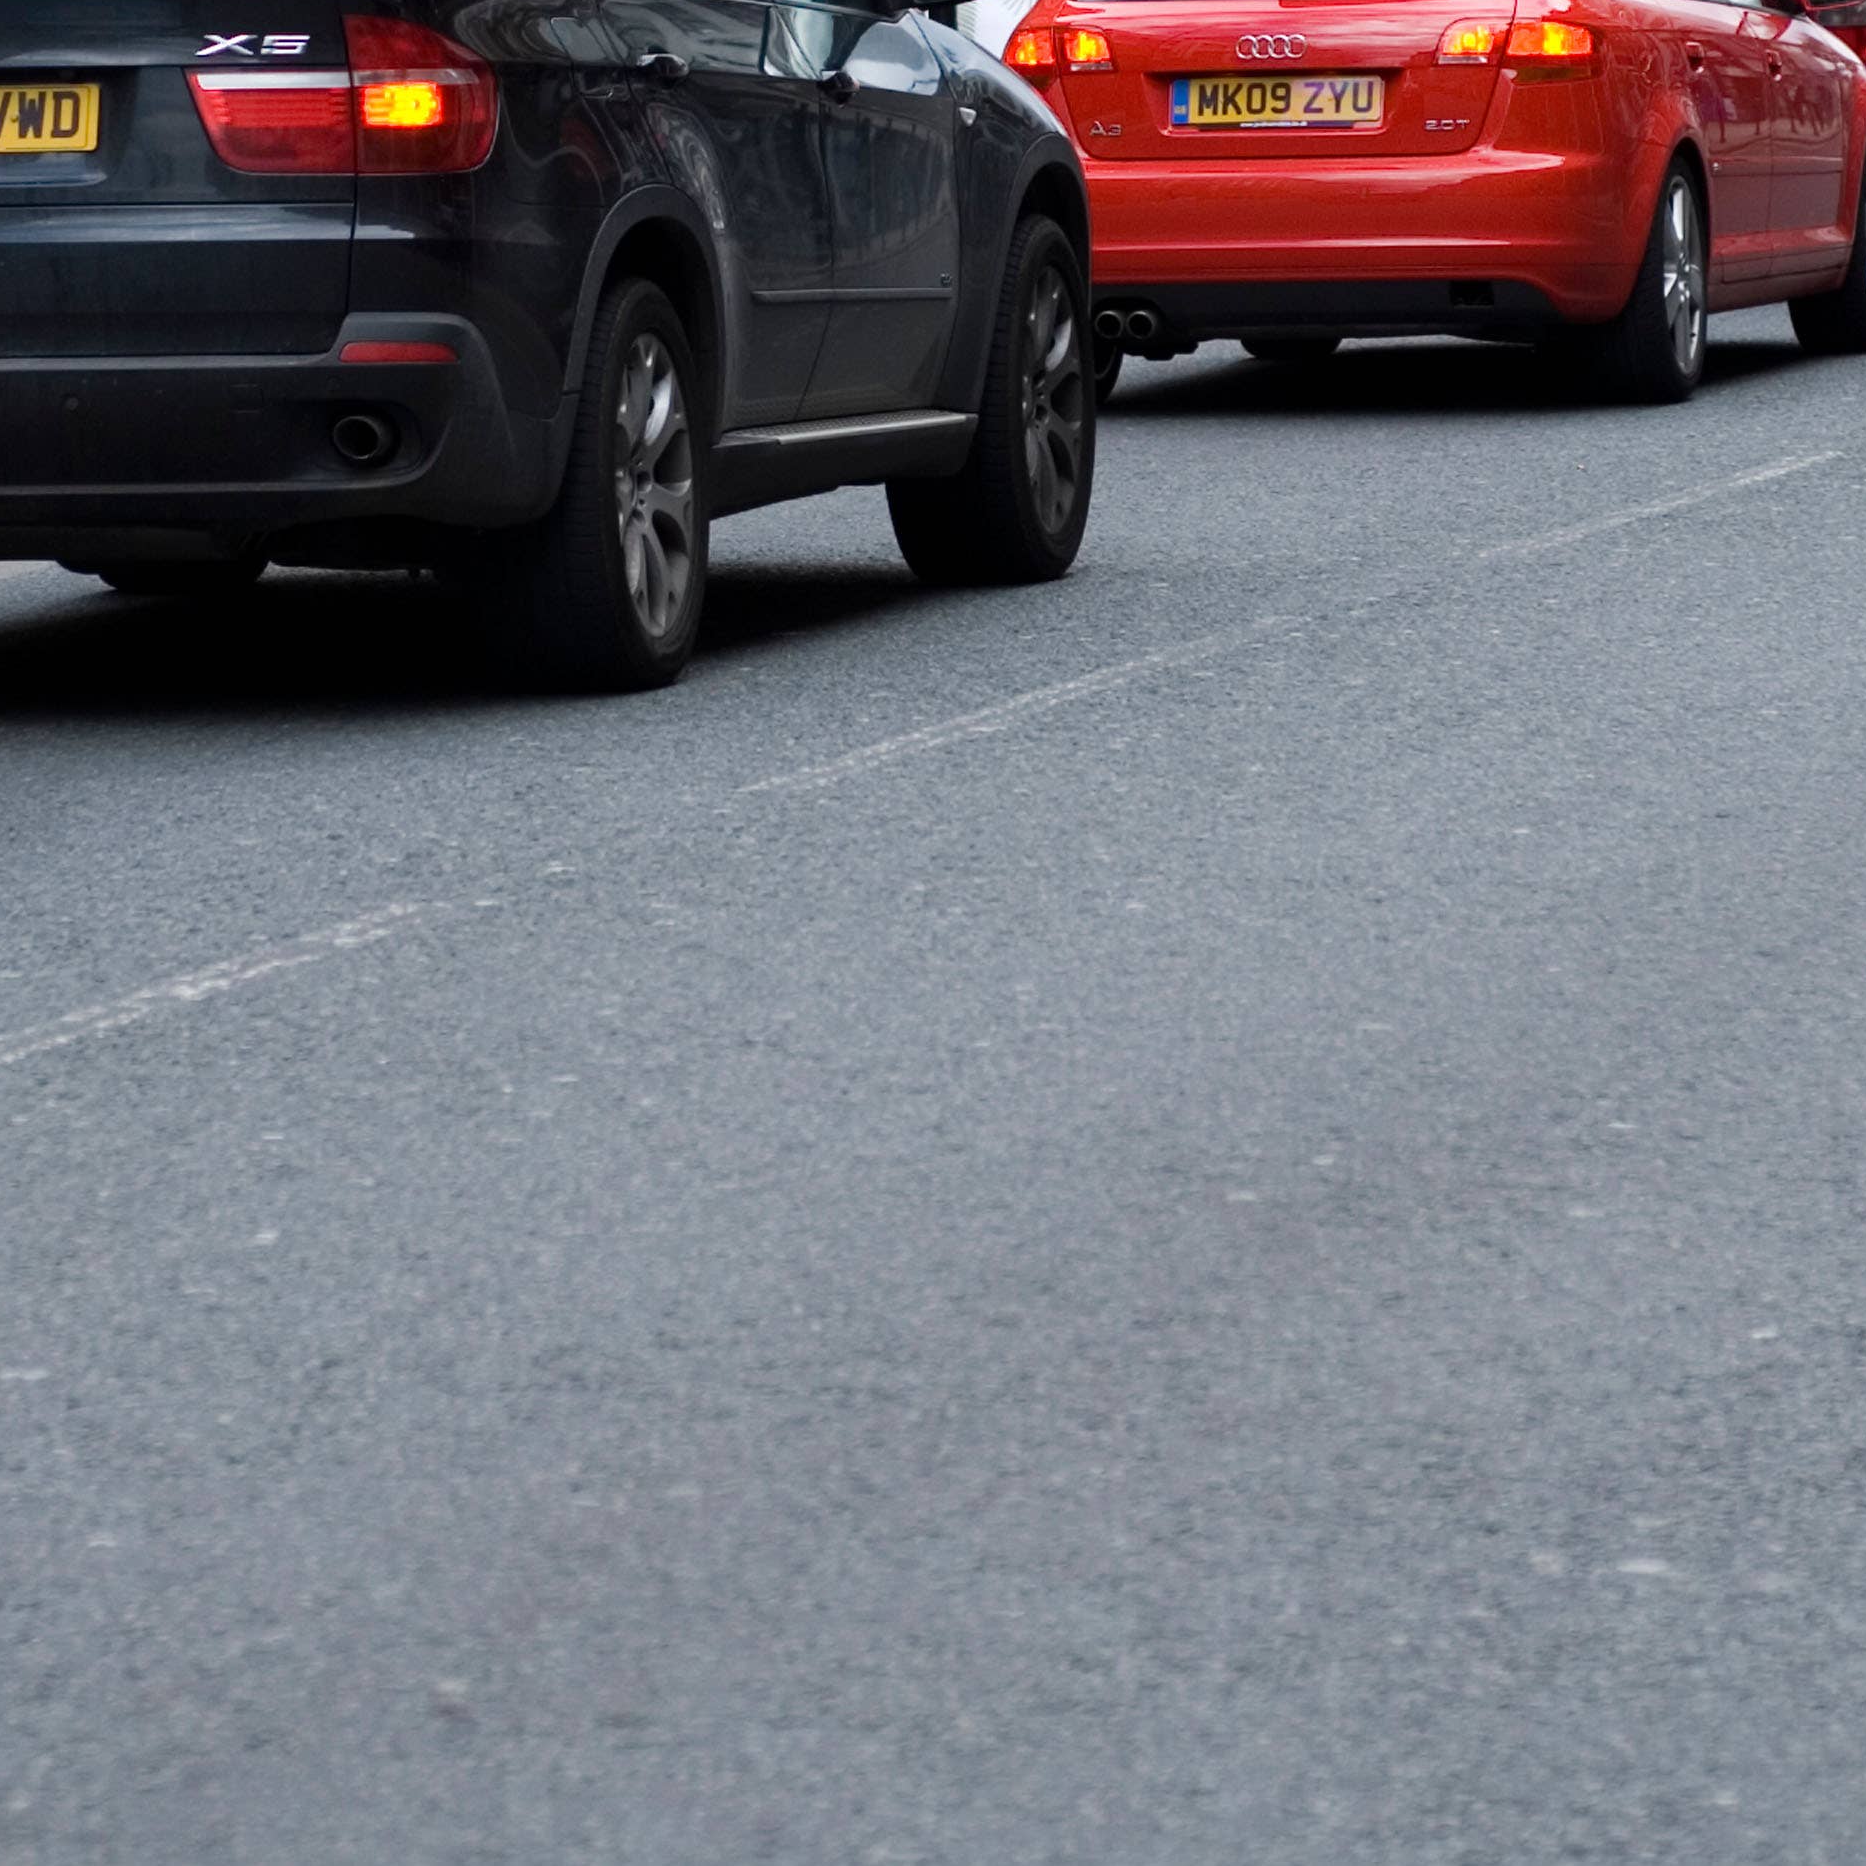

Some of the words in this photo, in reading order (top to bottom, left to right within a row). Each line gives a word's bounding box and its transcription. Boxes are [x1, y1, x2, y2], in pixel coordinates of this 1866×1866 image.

[195, 34, 310, 56] X5
[1198, 82, 1291, 116] MK09
[1303, 80, 1374, 114] ZYU
[1089, 121, 1122, 136] A3
